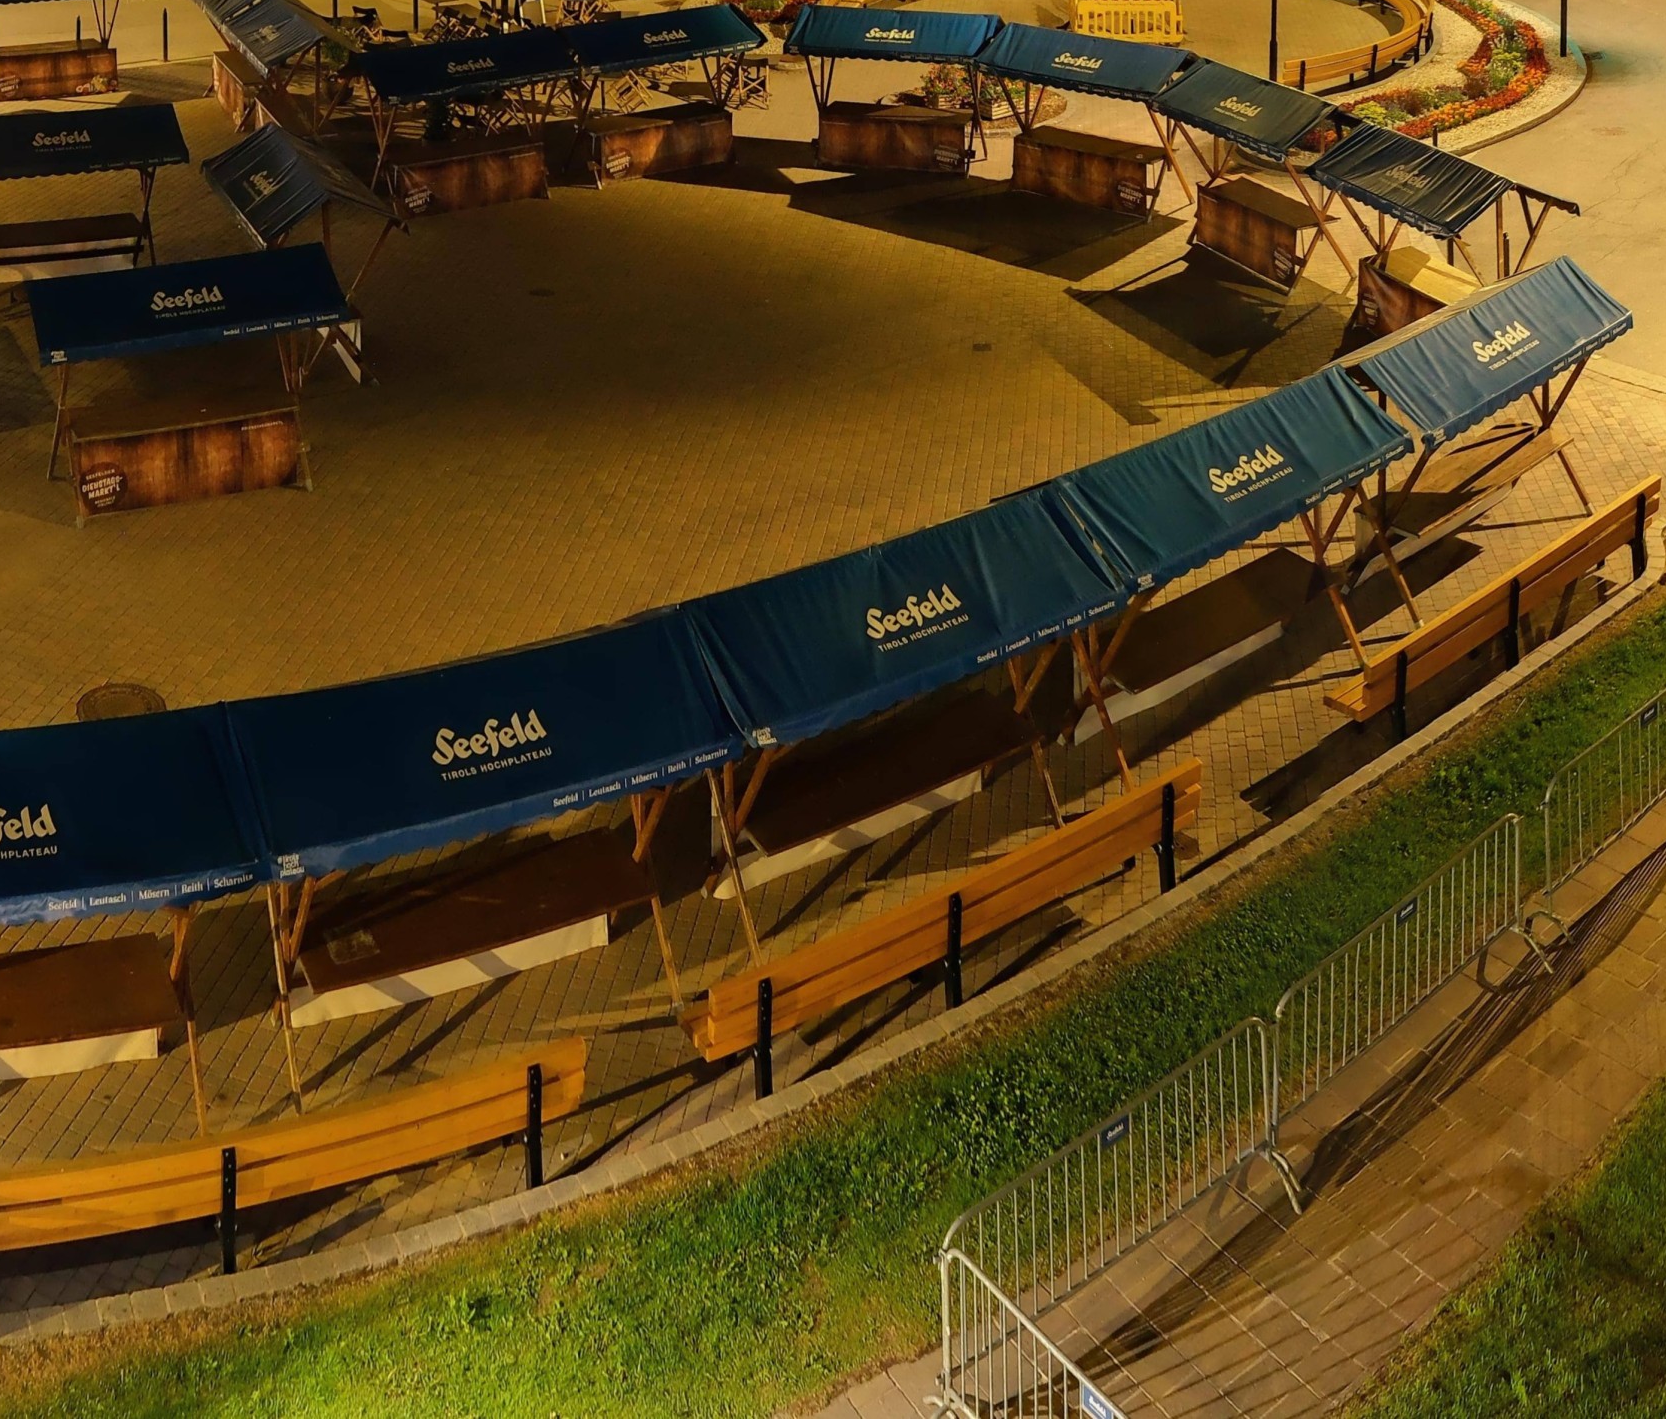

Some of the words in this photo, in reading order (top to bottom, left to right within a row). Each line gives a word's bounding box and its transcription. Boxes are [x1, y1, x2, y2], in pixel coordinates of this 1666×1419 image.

[643, 29, 688, 44] Seefeld
[865, 27, 915, 40] Seefeld
[447, 58, 495, 74] Seefeld
[1054, 52, 1103, 70] Seefeld
[1220, 96, 1264, 117] Seefeld
[33, 130, 90, 147] Seefeld
[151, 285, 224, 312] Seefeld
[1472, 320, 1531, 363] Seefeld
[1208, 443, 1284, 493] Seefeld
[866, 583, 962, 640] Seefeld
[878, 636, 909, 653] TIROLS
[910, 613, 969, 641] HOCHPLATEAU
[977, 649, 998, 664] Seefeld
[1005, 636, 1030, 653] Leutasch
[1067, 614, 1082, 626] Reith
[1088, 600, 1116, 617] Scharnitz
[432, 709, 547, 766] Seefeld
[441, 766, 477, 782] TIROLS
[481, 747, 552, 773] HOCHPLATEAU
[553, 792, 579, 808] Seefeld
[588, 781, 621, 798] Leutasch
[631, 770, 658, 786] Mösern
[667, 761, 687, 775] Reith
[695, 748, 729, 765] Scharnitz
[48, 899, 78, 912] Seefeld
[89, 893, 127, 907] Leutasch
[138, 887, 170, 900] Mösern
[181, 881, 204, 894] Reith
[213, 873, 253, 889] Scharnitz
